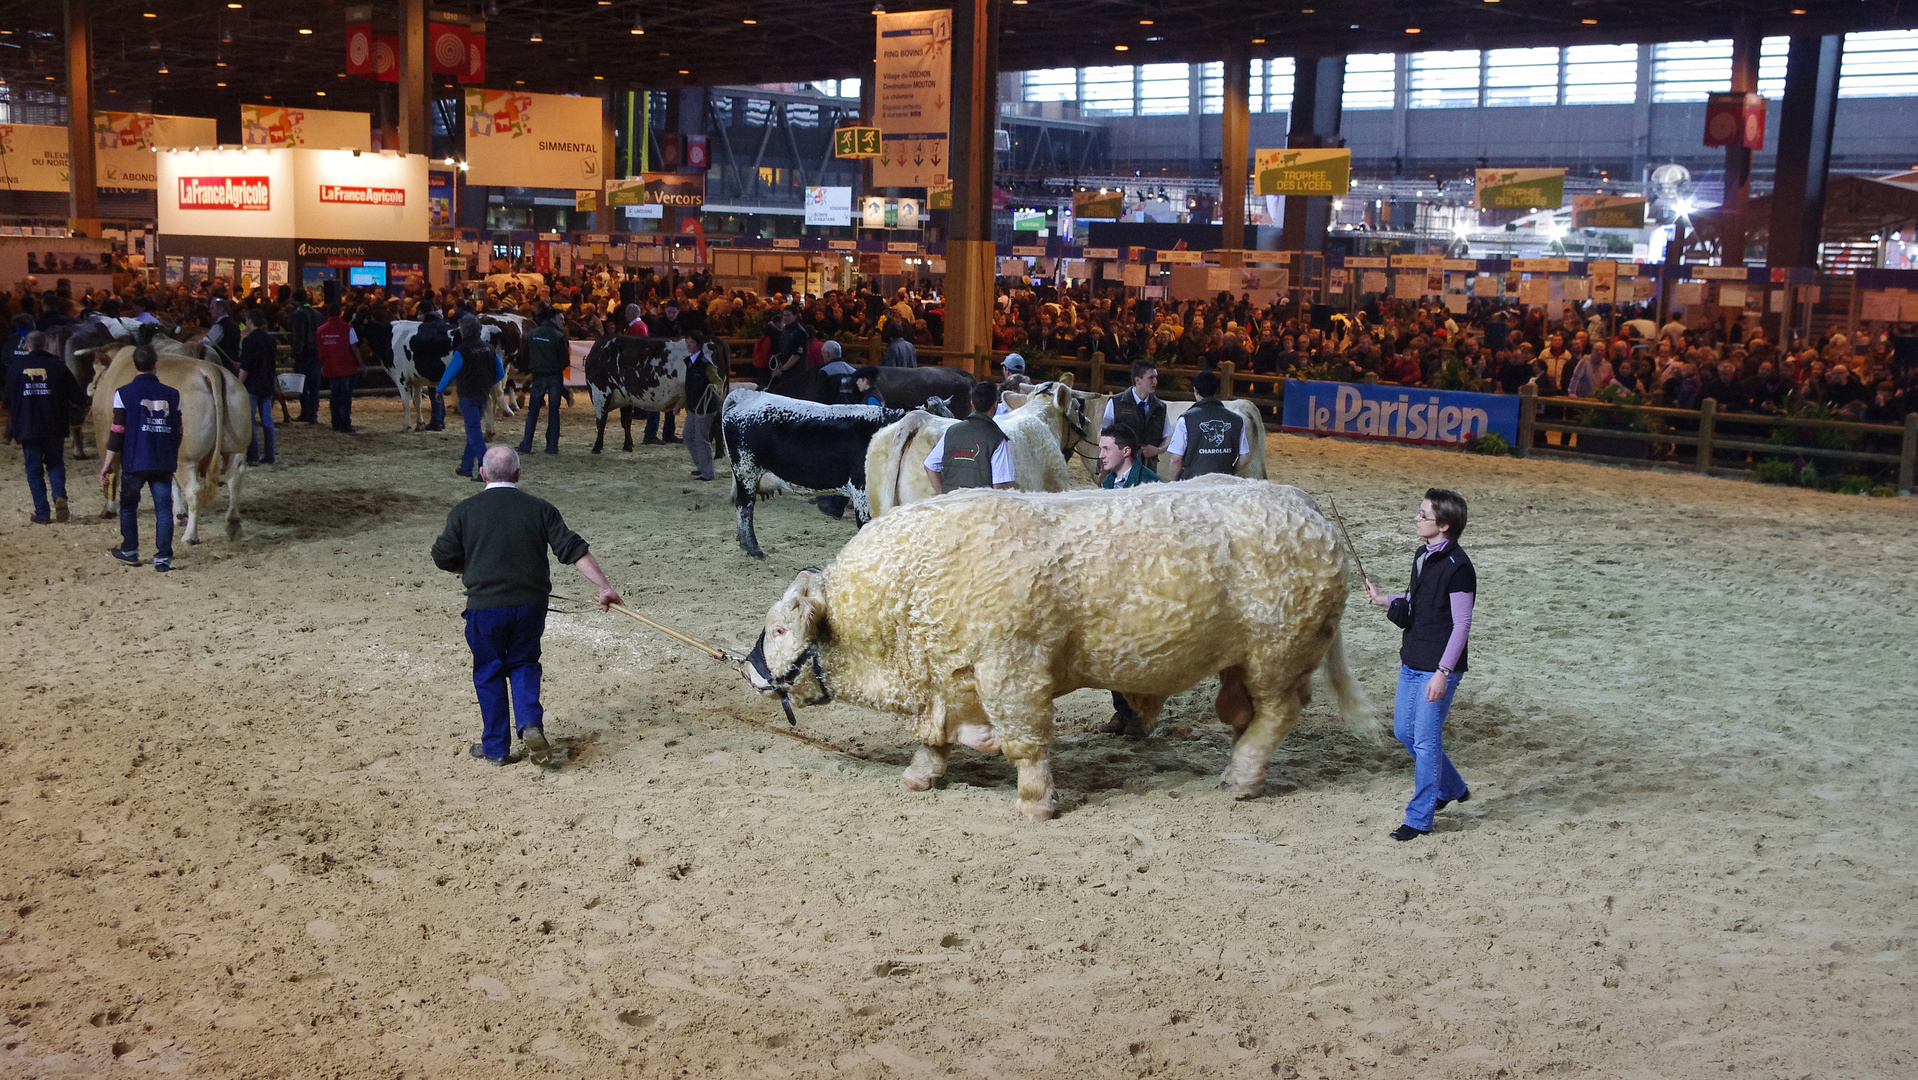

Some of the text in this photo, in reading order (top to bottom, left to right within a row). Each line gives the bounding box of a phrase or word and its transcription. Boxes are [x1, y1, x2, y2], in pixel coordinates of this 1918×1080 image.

[884, 49, 924, 58] RING BOVINS
[883, 72, 900, 80] Village
[909, 70, 931, 78] COCHON
[913, 80, 936, 88] MOUTON
[539, 141, 598, 153] SIMMENTAL
[917, 142, 922, 152] 4
[935, 142, 940, 152] 7
[32, 158, 44, 166] DU
[1283, 170, 1327, 180] TROPHEE
[1277, 180, 1332, 190] DES LYCEES
[654, 190, 702, 205] Vercors
[1308, 385, 1489, 444] le Parisien
